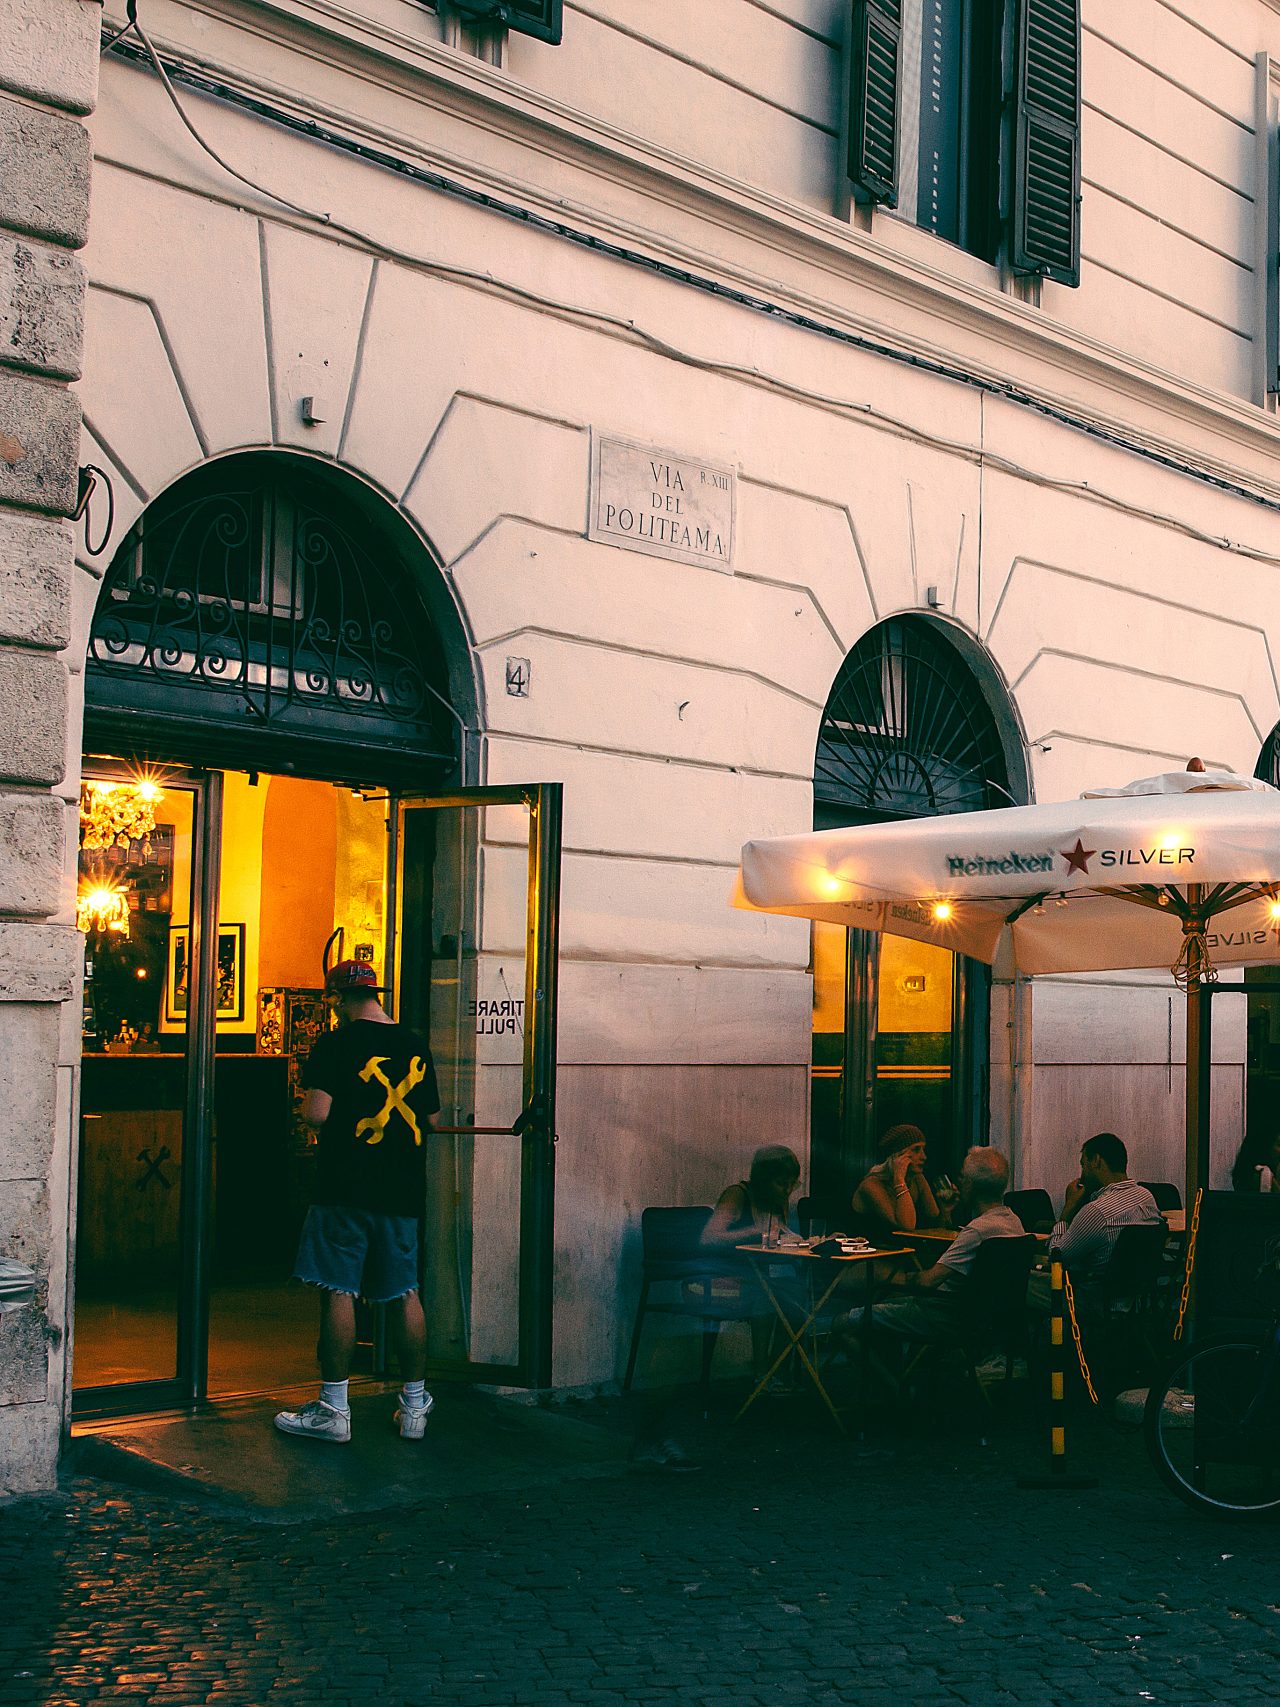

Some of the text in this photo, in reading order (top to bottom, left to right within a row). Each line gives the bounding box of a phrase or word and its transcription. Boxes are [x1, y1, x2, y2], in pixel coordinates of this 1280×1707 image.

[650, 461, 685, 492] VIA
[712, 474, 729, 491] XIII
[652, 492, 684, 515] DEL
[605, 504, 723, 555] POLITEAMA
[510, 665, 526, 693] 4
[945, 847, 1196, 878] Heineken SILVER
